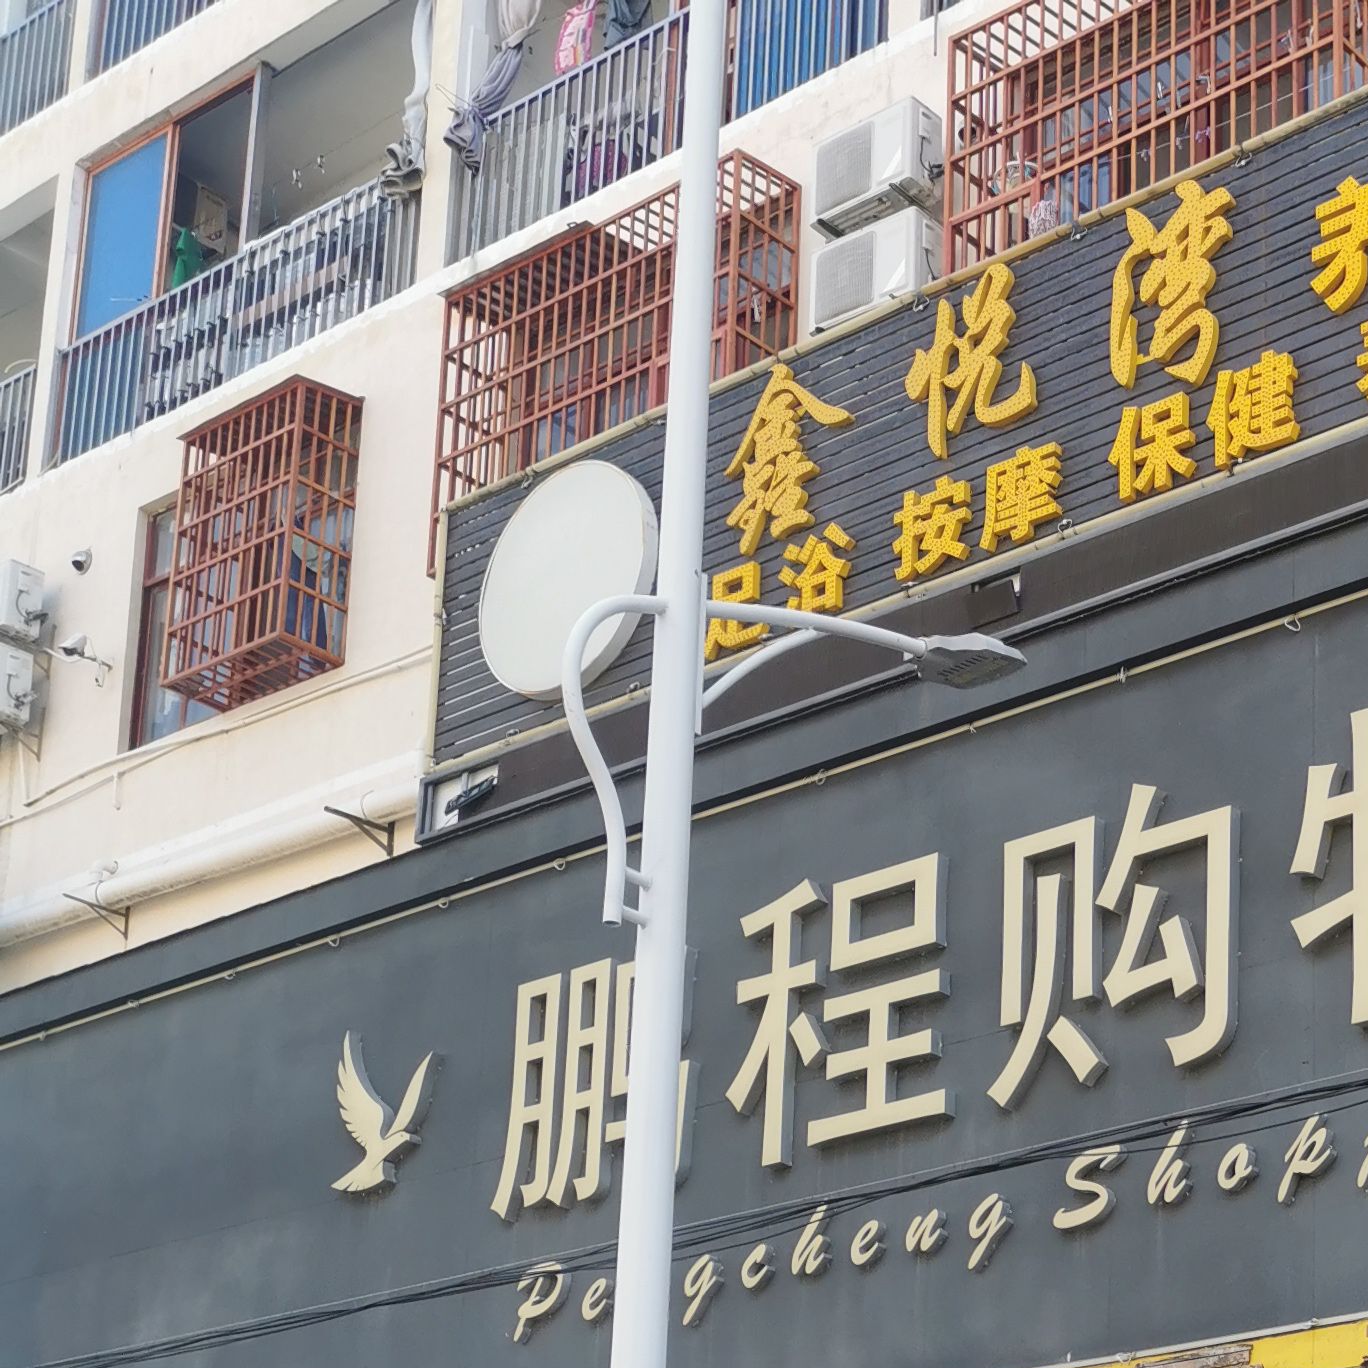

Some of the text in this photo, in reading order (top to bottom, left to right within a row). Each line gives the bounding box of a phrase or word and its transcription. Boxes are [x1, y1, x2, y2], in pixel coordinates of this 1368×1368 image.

[892, 441, 1065, 584] 按摩
[1108, 350, 1302, 505] 保健
[511, 1191, 1014, 1343] Pegcheng
